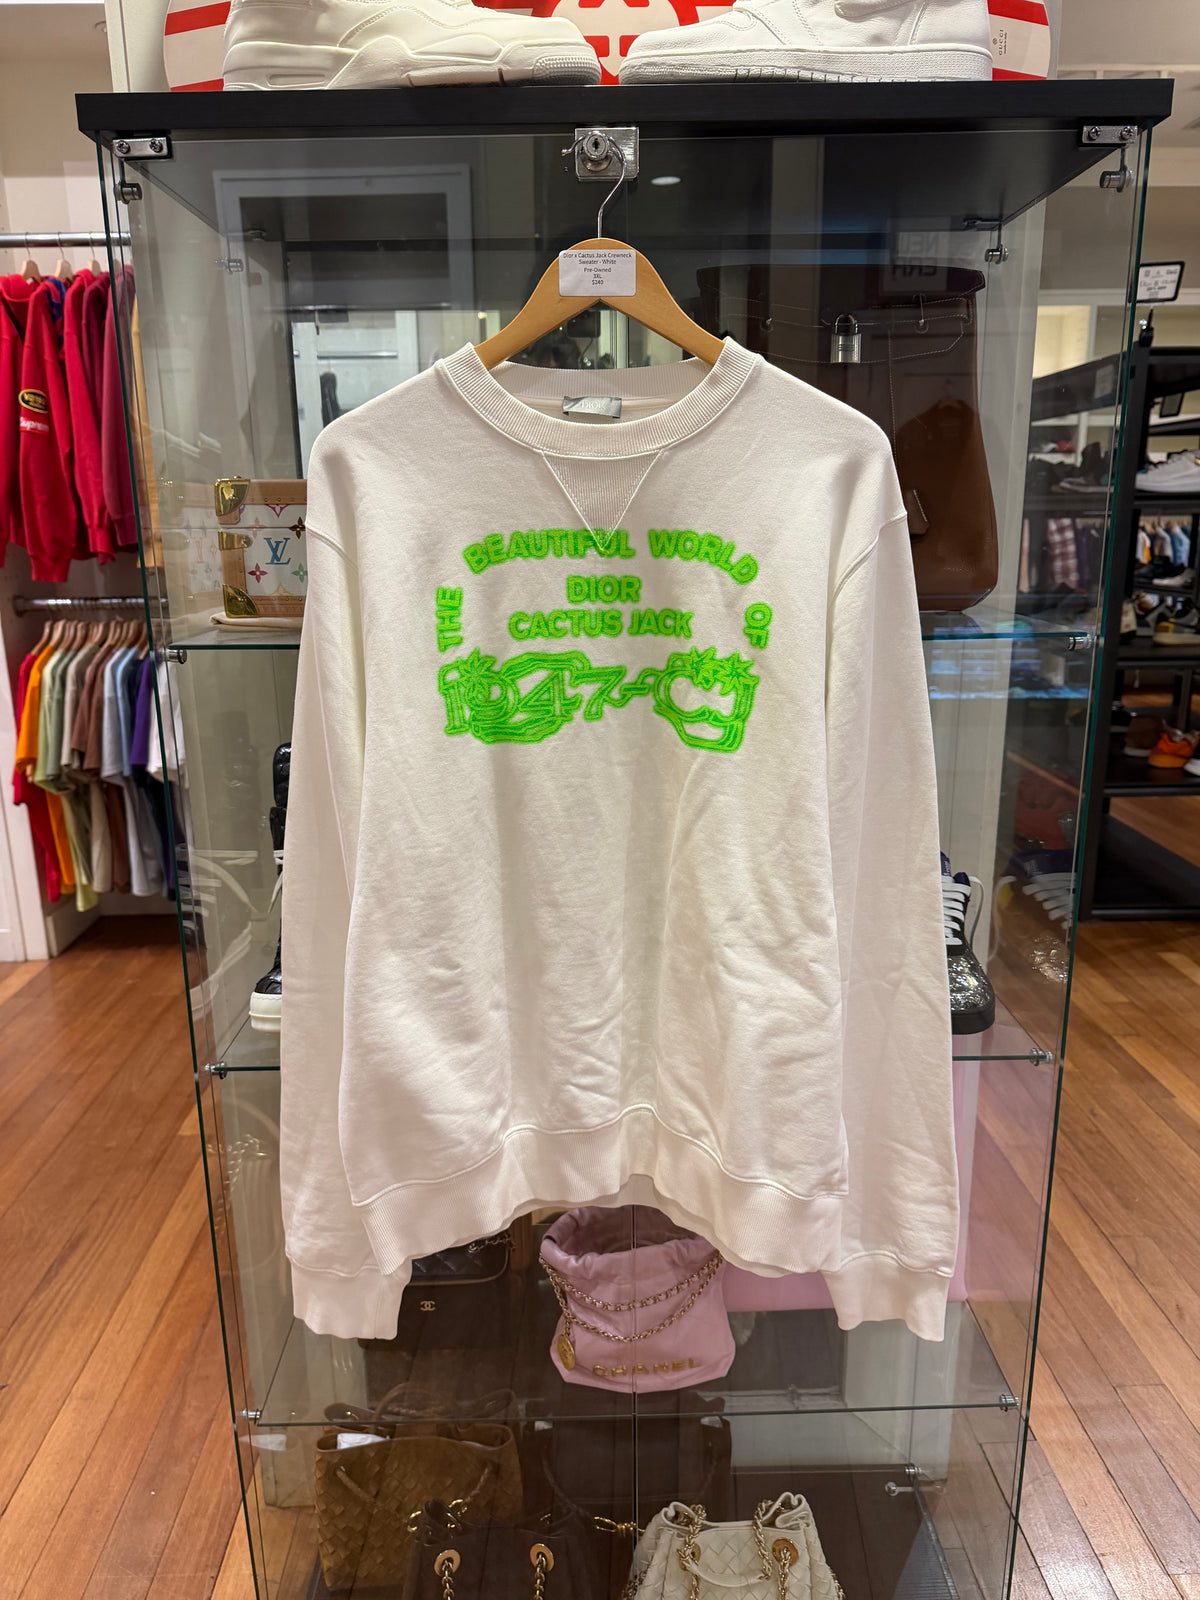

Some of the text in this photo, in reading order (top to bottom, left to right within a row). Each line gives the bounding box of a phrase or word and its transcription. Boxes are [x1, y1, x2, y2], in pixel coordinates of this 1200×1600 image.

[19, 416, 50, 433] Suprem
[435, 528, 773, 653] THE BEAUTIFUL WORLD OF
[565, 574, 643, 605] DIOR
[508, 607, 694, 642] CACTUS JACK
[592, 1357, 702, 1379] CHANEL
